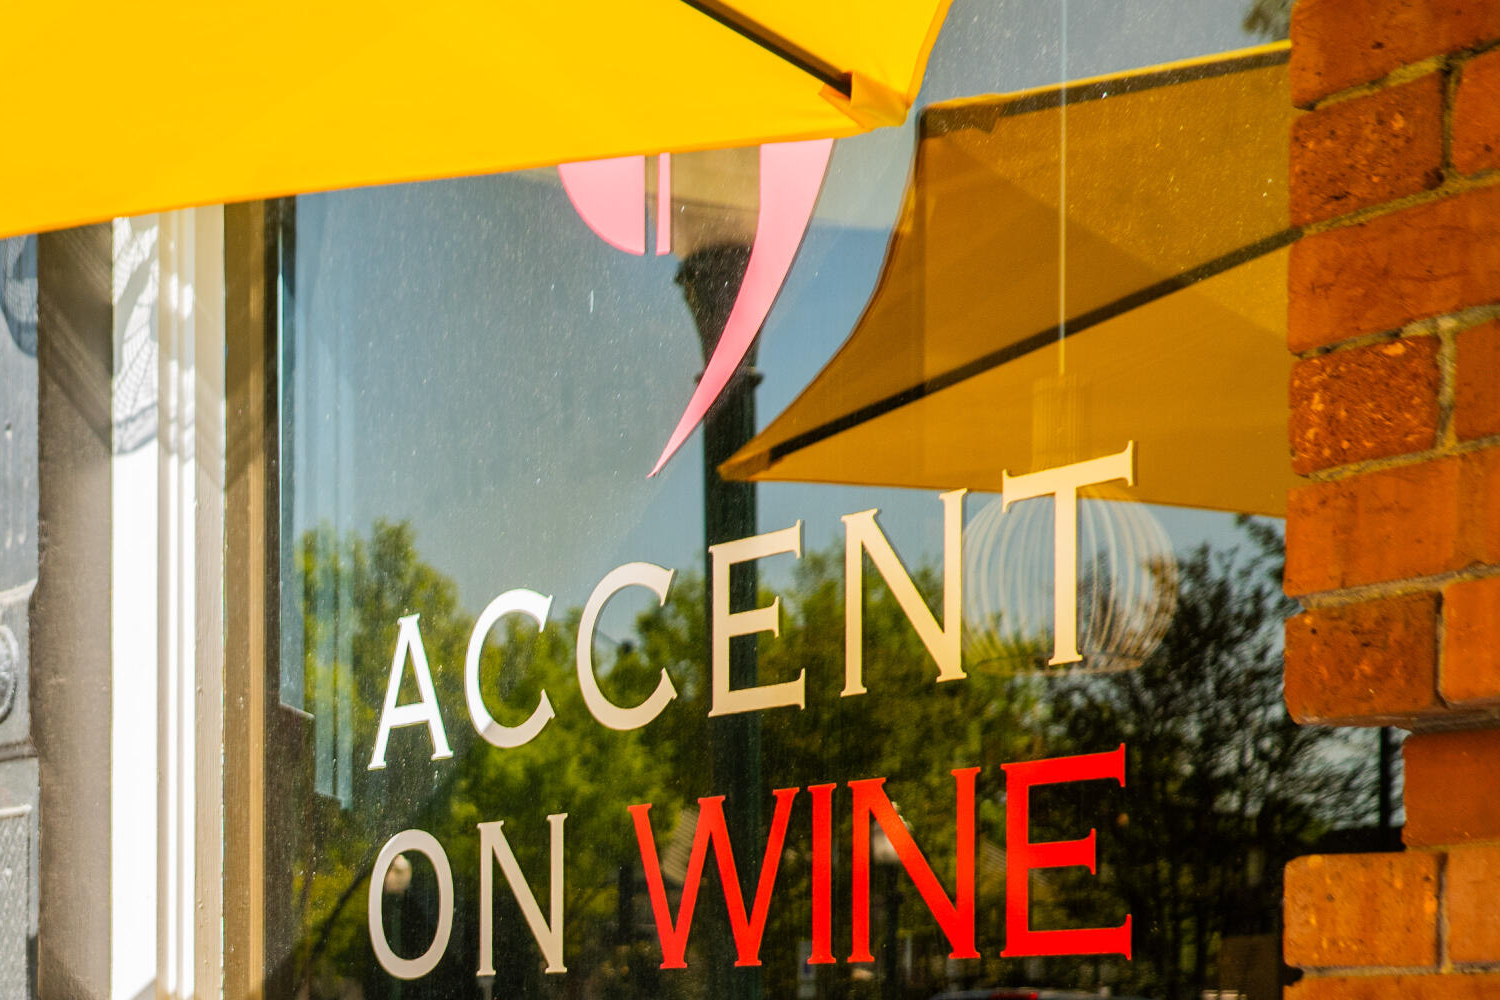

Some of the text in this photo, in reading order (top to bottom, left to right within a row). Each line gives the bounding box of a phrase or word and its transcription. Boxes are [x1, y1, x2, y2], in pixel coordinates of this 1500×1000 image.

[368, 440, 1137, 769] ACCENT
[369, 742, 1132, 980] ON WINE
